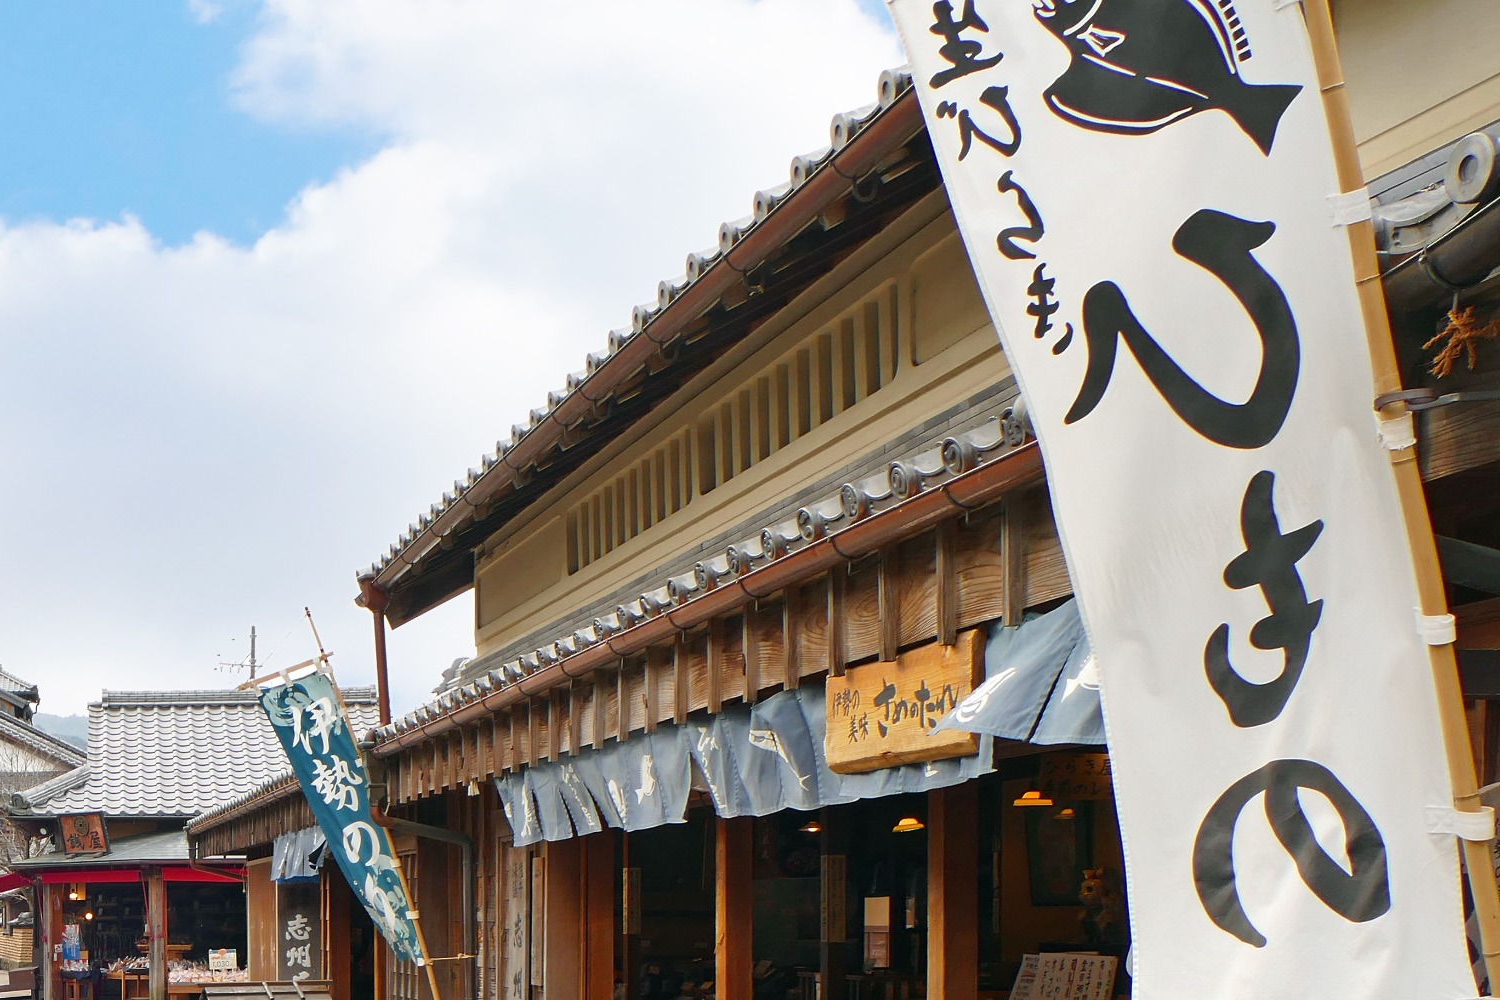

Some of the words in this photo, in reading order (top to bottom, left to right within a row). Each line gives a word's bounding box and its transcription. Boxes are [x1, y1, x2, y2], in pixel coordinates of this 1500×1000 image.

[832, 687, 860, 719] 伊勢の
[848, 711, 870, 744] 美味
